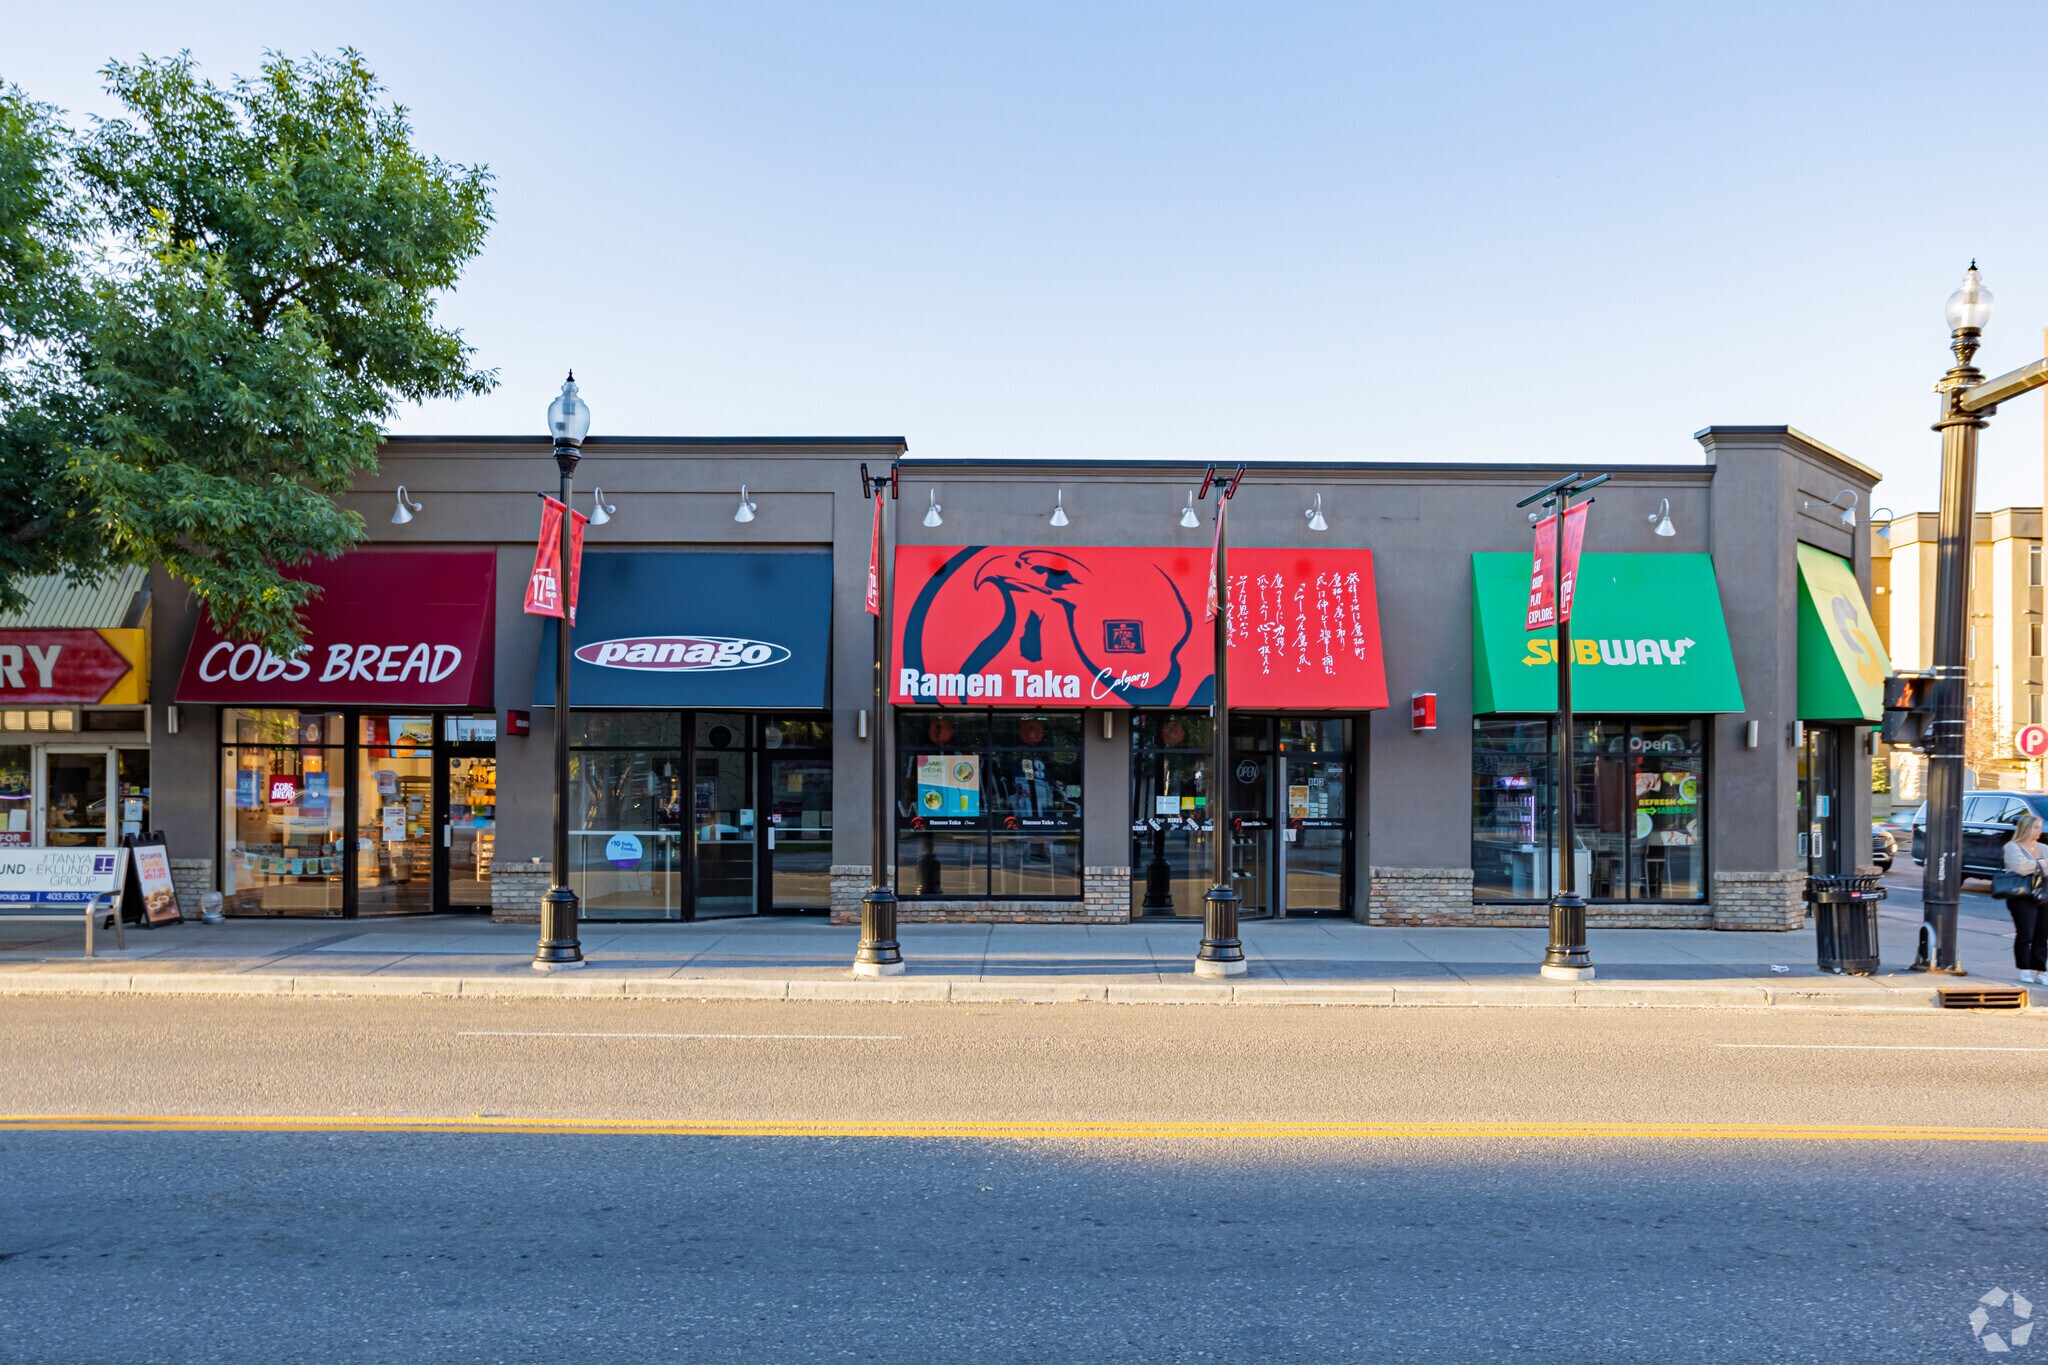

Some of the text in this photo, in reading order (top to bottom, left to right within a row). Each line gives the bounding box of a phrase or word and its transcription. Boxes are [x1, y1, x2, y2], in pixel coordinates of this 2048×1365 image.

[1533, 558, 1542, 574] EAT
[1531, 574, 1544, 590] SHOP
[1530, 591, 1542, 608] PLAY
[1528, 606, 1554, 624] EXPLORE
[595, 639, 772, 667] panago
[199, 641, 462, 683] COBS BREAD
[900, 666, 1151, 700] Ramen Taka Calgary
[1630, 736, 1672, 753] Open
[2026, 729, 2044, 753] P
[271, 790, 296, 800] BREAD
[273, 782, 294, 792] COBS
[1638, 798, 1677, 806] REFRESH
[50, 853, 92, 864] TANYA
[36, 863, 90, 875] EKLUND
[50, 875, 97, 886] GROUP
